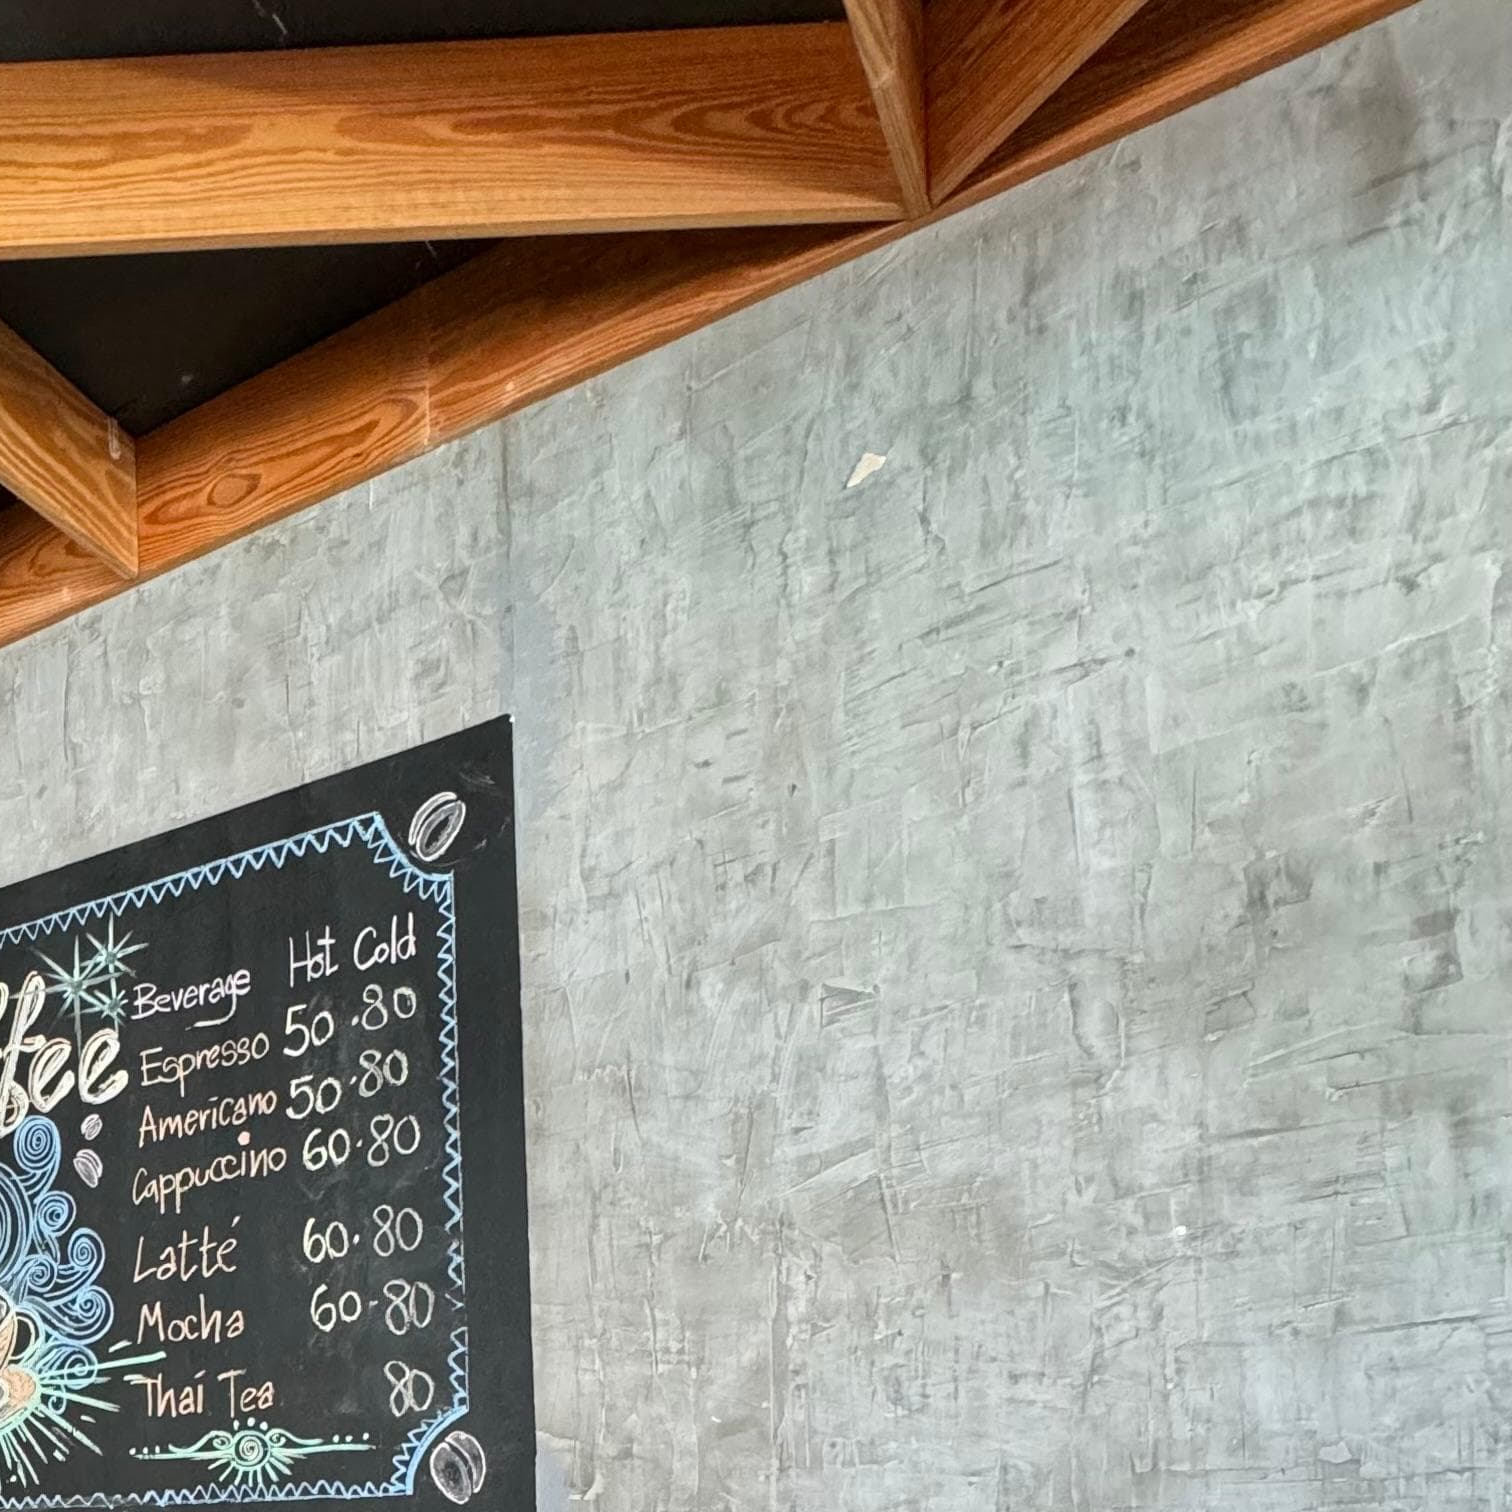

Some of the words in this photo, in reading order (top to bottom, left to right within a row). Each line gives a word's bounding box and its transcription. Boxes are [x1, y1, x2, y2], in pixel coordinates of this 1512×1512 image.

[131, 970, 250, 1030] Beverage
[289, 926, 338, 988] Hot
[353, 912, 416, 970] Cold
[139, 1033, 269, 1097] Espresso
[283, 1004, 334, 1056] 50
[138, 1090, 277, 1148] Americano
[132, 1131, 287, 1214] Cappuccino
[137, 1294, 245, 1344] Mocha
[129, 1370, 207, 1418] Thai
[217, 1369, 275, 1418] Tea
[384, 1360, 435, 1418] 80
